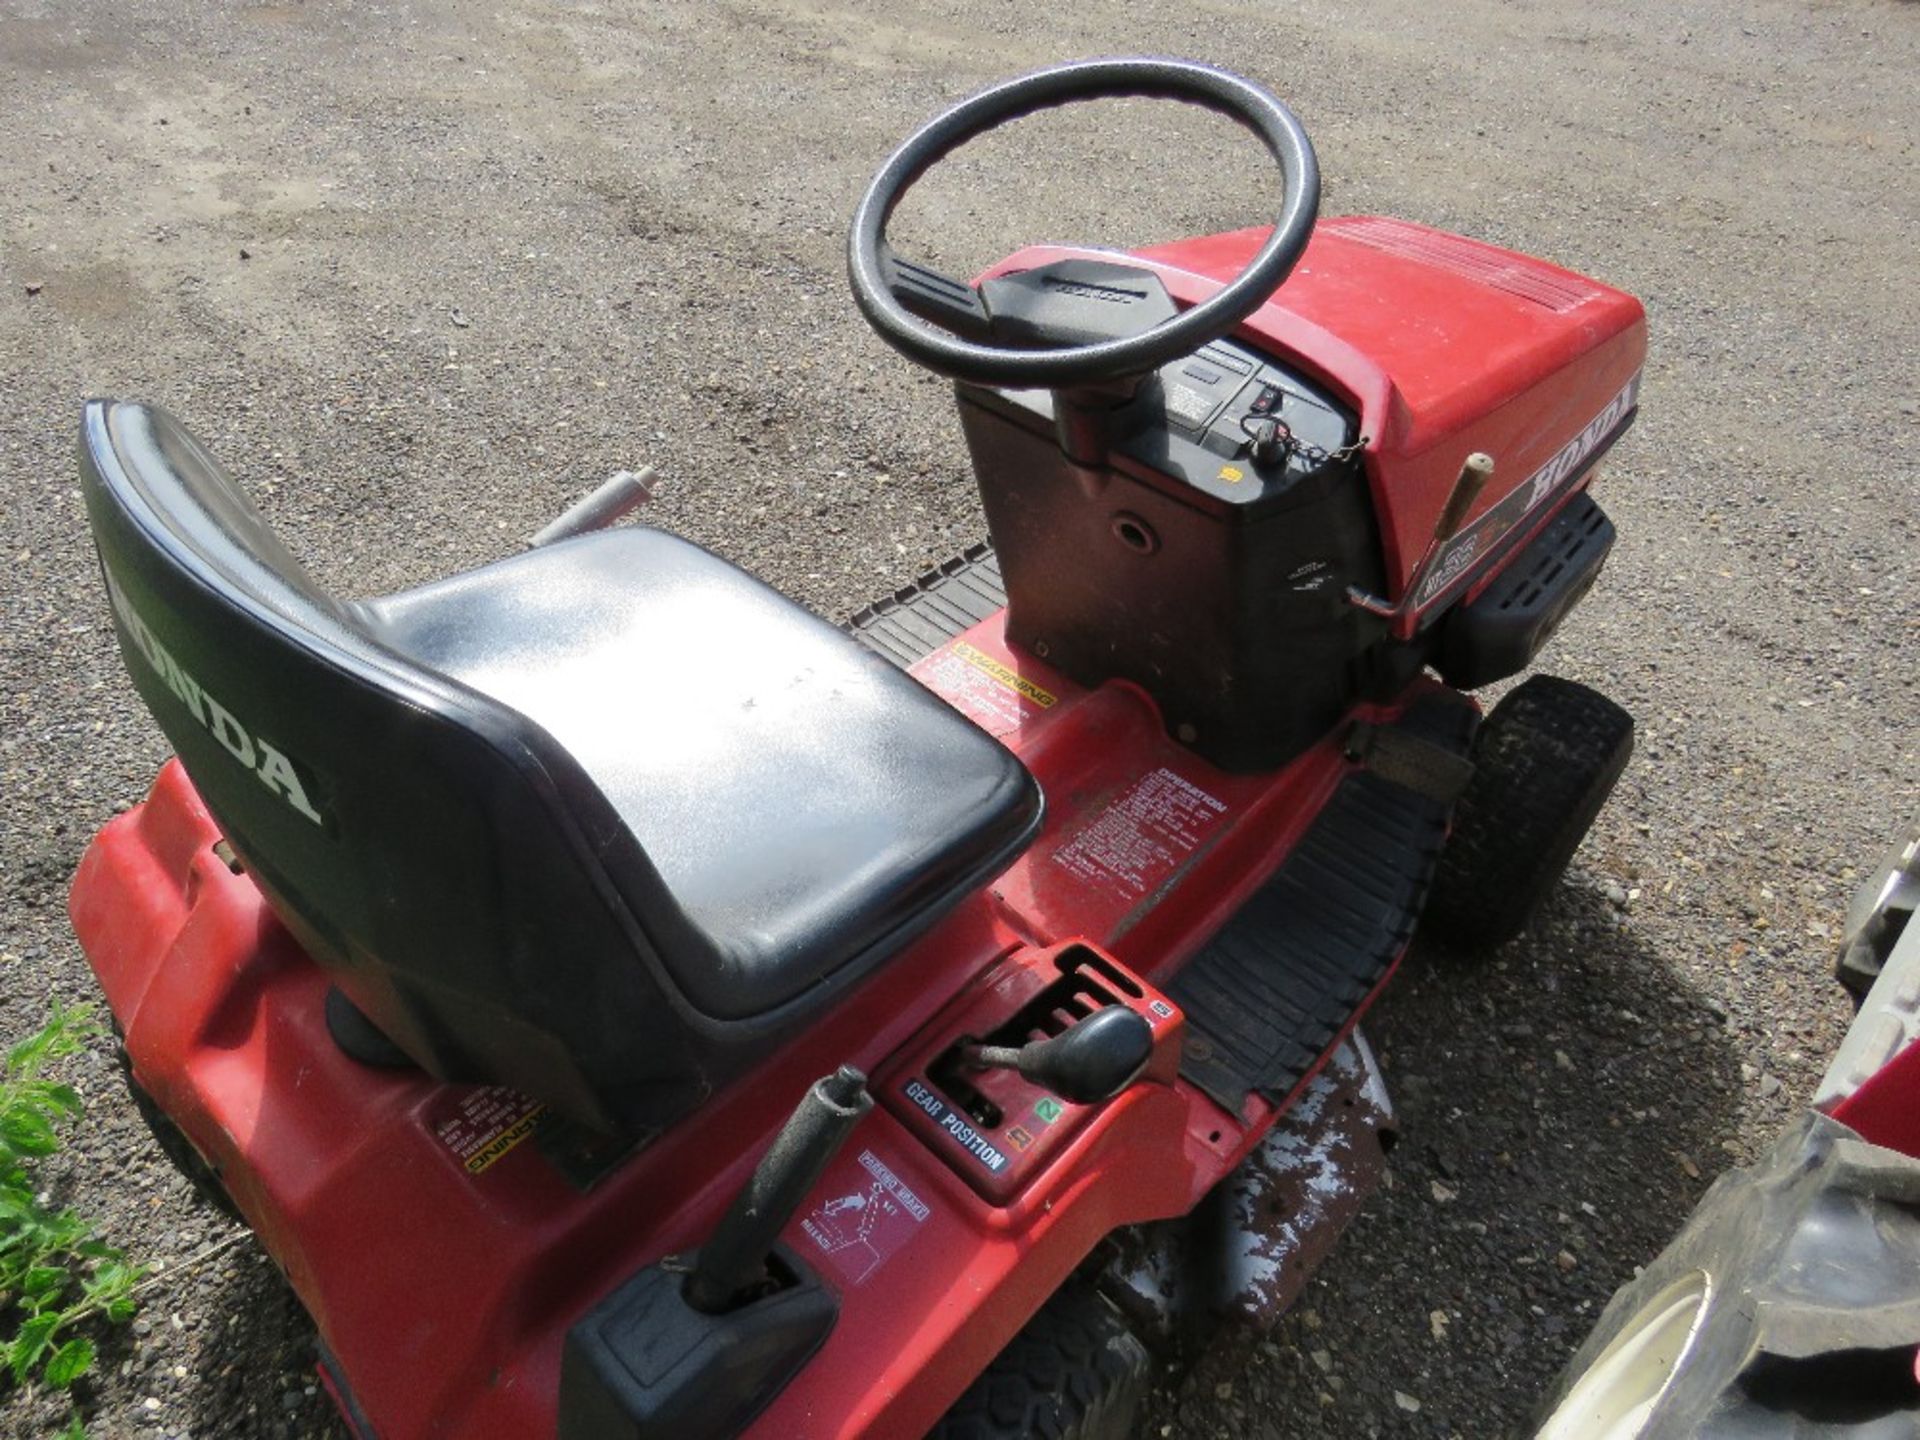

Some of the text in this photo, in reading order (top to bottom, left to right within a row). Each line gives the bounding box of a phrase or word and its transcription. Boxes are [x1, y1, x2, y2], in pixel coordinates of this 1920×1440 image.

[467, 1105, 550, 1172] ARNING
[904, 1080, 1006, 1171] GEAR POSITION
[1036, 1099, 1061, 1120] N
